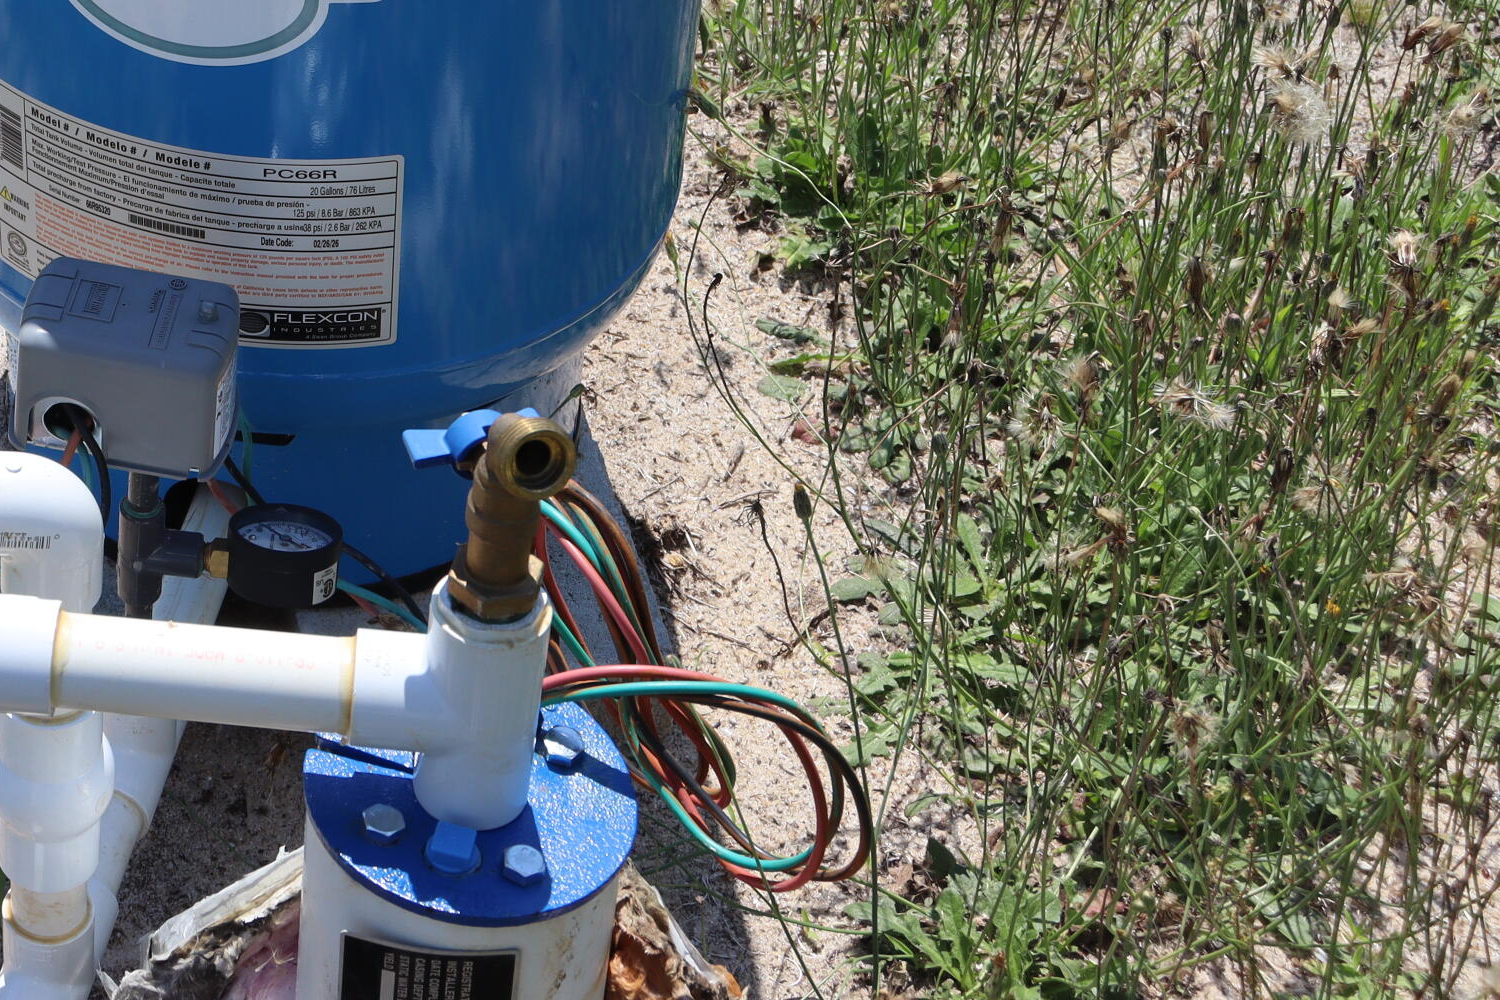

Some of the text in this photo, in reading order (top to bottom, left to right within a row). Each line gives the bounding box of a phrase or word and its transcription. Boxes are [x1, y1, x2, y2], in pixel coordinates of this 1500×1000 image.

[31, 107, 60, 129] Model
[63, 122, 69, 133] #
[86, 131, 127, 153] Modelo
[130, 145, 137, 156] #
[156, 152, 200, 169] Modele
[203, 161, 211, 171] #
[31, 122, 45, 135] Total
[46, 130, 59, 142] Tank
[60, 137, 83, 152] Volume
[89, 148, 117, 164] Volumen
[119, 159, 134, 169] total
[136, 163, 146, 172] del
[148, 167, 173, 179] tanque
[215, 180, 236, 188] totale
[32, 138, 45, 150] Max.
[46, 145, 86, 169] Working/Test
[87, 163, 116, 179] Pressure
[131, 178, 188, 196] funcionamiento
[237, 198, 265, 207] prueba
[32, 146, 165, 199] Fonctionnement Maximum/Pression d'essai
[264, 168, 337, 179] PC66R
[32, 160, 45, 173] Total
[46, 167, 76, 188] precharge
[77, 181, 92, 193] from
[94, 188, 116, 202] factory
[123, 198, 153, 213] Precarga
[155, 206, 164, 214] de
[165, 209, 190, 219] fabrica
[191, 214, 203, 222] del
[205, 216, 230, 227] tanque
[237, 221, 275, 231] precharge
[310, 187, 319, 195] 20
[320, 187, 344, 195] Gallons
[359, 185, 376, 194] Litres
[10, 192, 29, 210] WARNING
[293, 209, 304, 217] 125
[306, 210, 316, 219] psi
[321, 209, 332, 217] 8.6
[332, 209, 344, 217] Bar
[362, 207, 376, 216] KPA
[303, 224, 311, 232] 38
[313, 224, 323, 233] psi
[328, 223, 339, 231] 2.6
[340, 223, 350, 231] Bar
[368, 220, 382, 229] KPA
[261, 237, 294, 247] Date Code:
[274, 310, 378, 324] FLEXCON
[273, 324, 376, 333] INDUSTRIES
[384, 952, 394, 970] YIELD
[399, 955, 410, 976] STATIC
[430, 959, 441, 977] DATE
[414, 958, 426, 983] CASING
